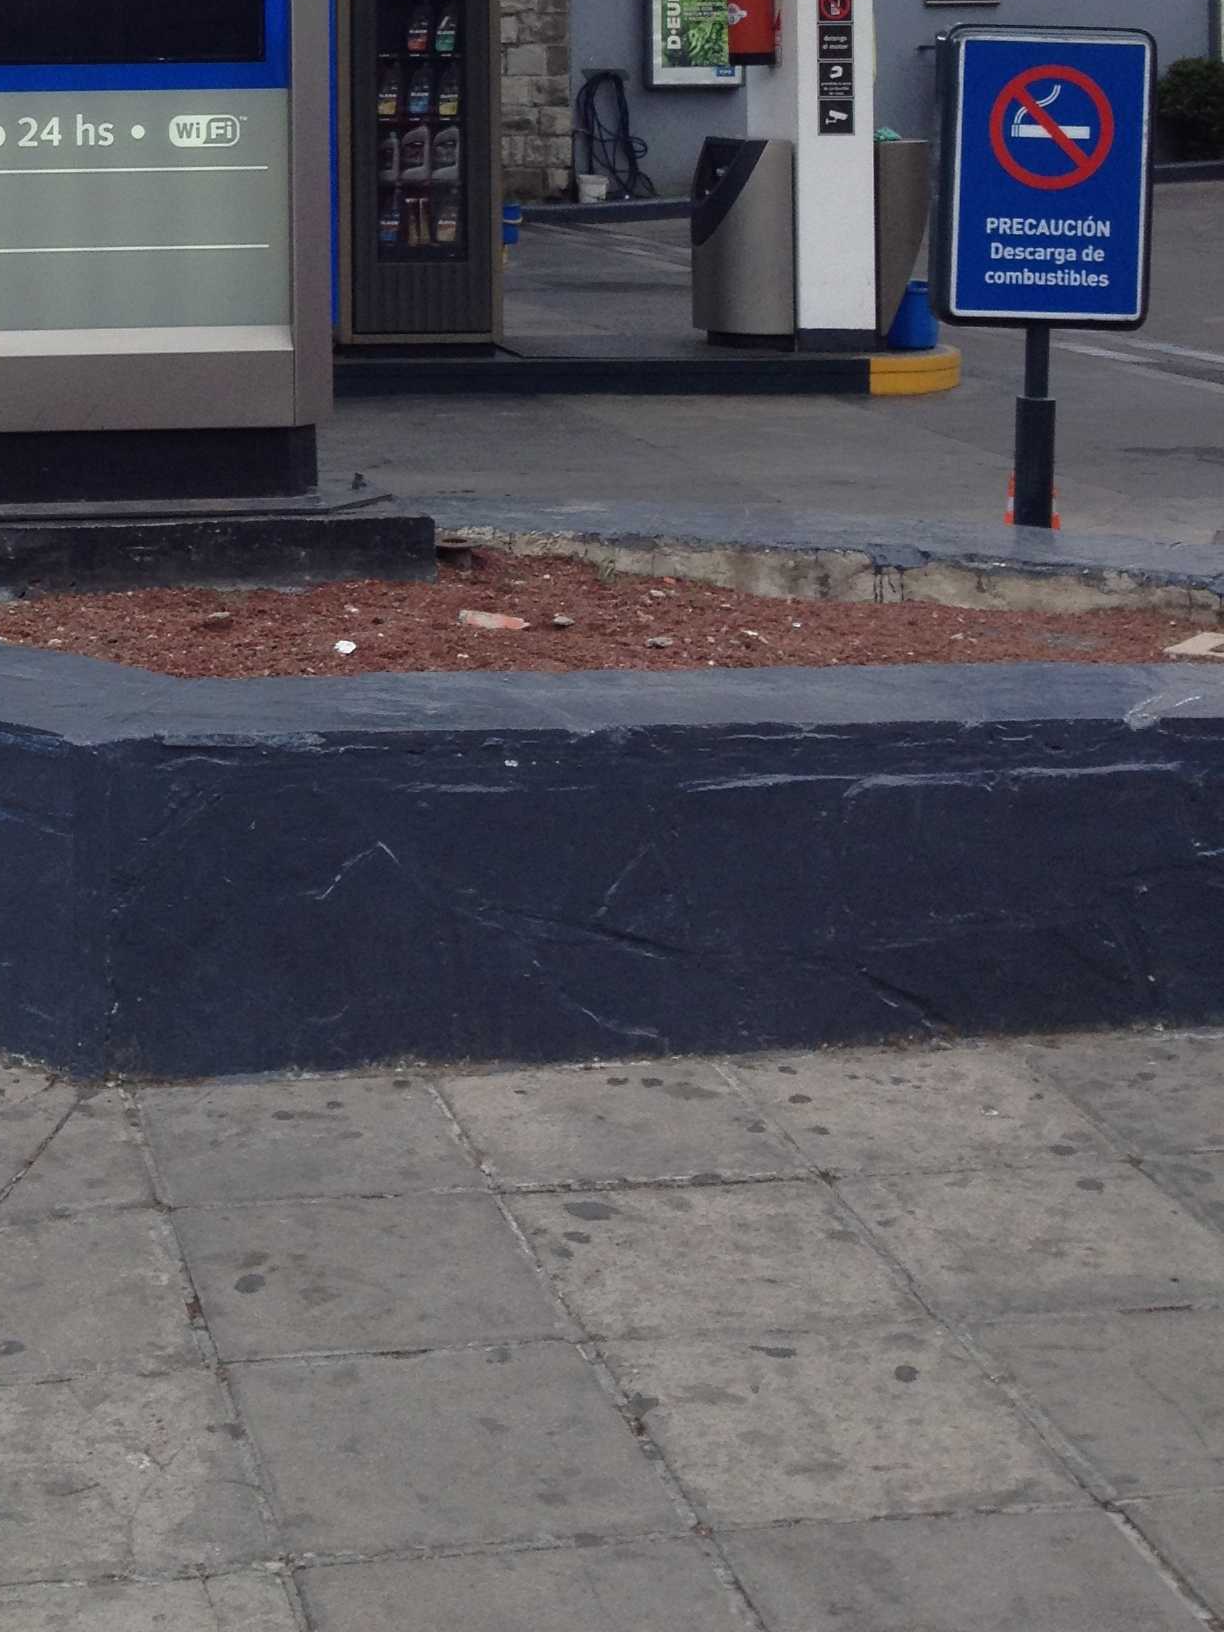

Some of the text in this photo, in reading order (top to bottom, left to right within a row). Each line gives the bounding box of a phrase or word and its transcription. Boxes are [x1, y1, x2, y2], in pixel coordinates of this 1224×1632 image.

[17, 116, 63, 147] 24
[76, 113, 115, 146] hs
[986, 216, 1111, 237] PRECAUCIÓN
[990, 242, 1105, 264] Descarga de
[984, 268, 1110, 287] combustibles
